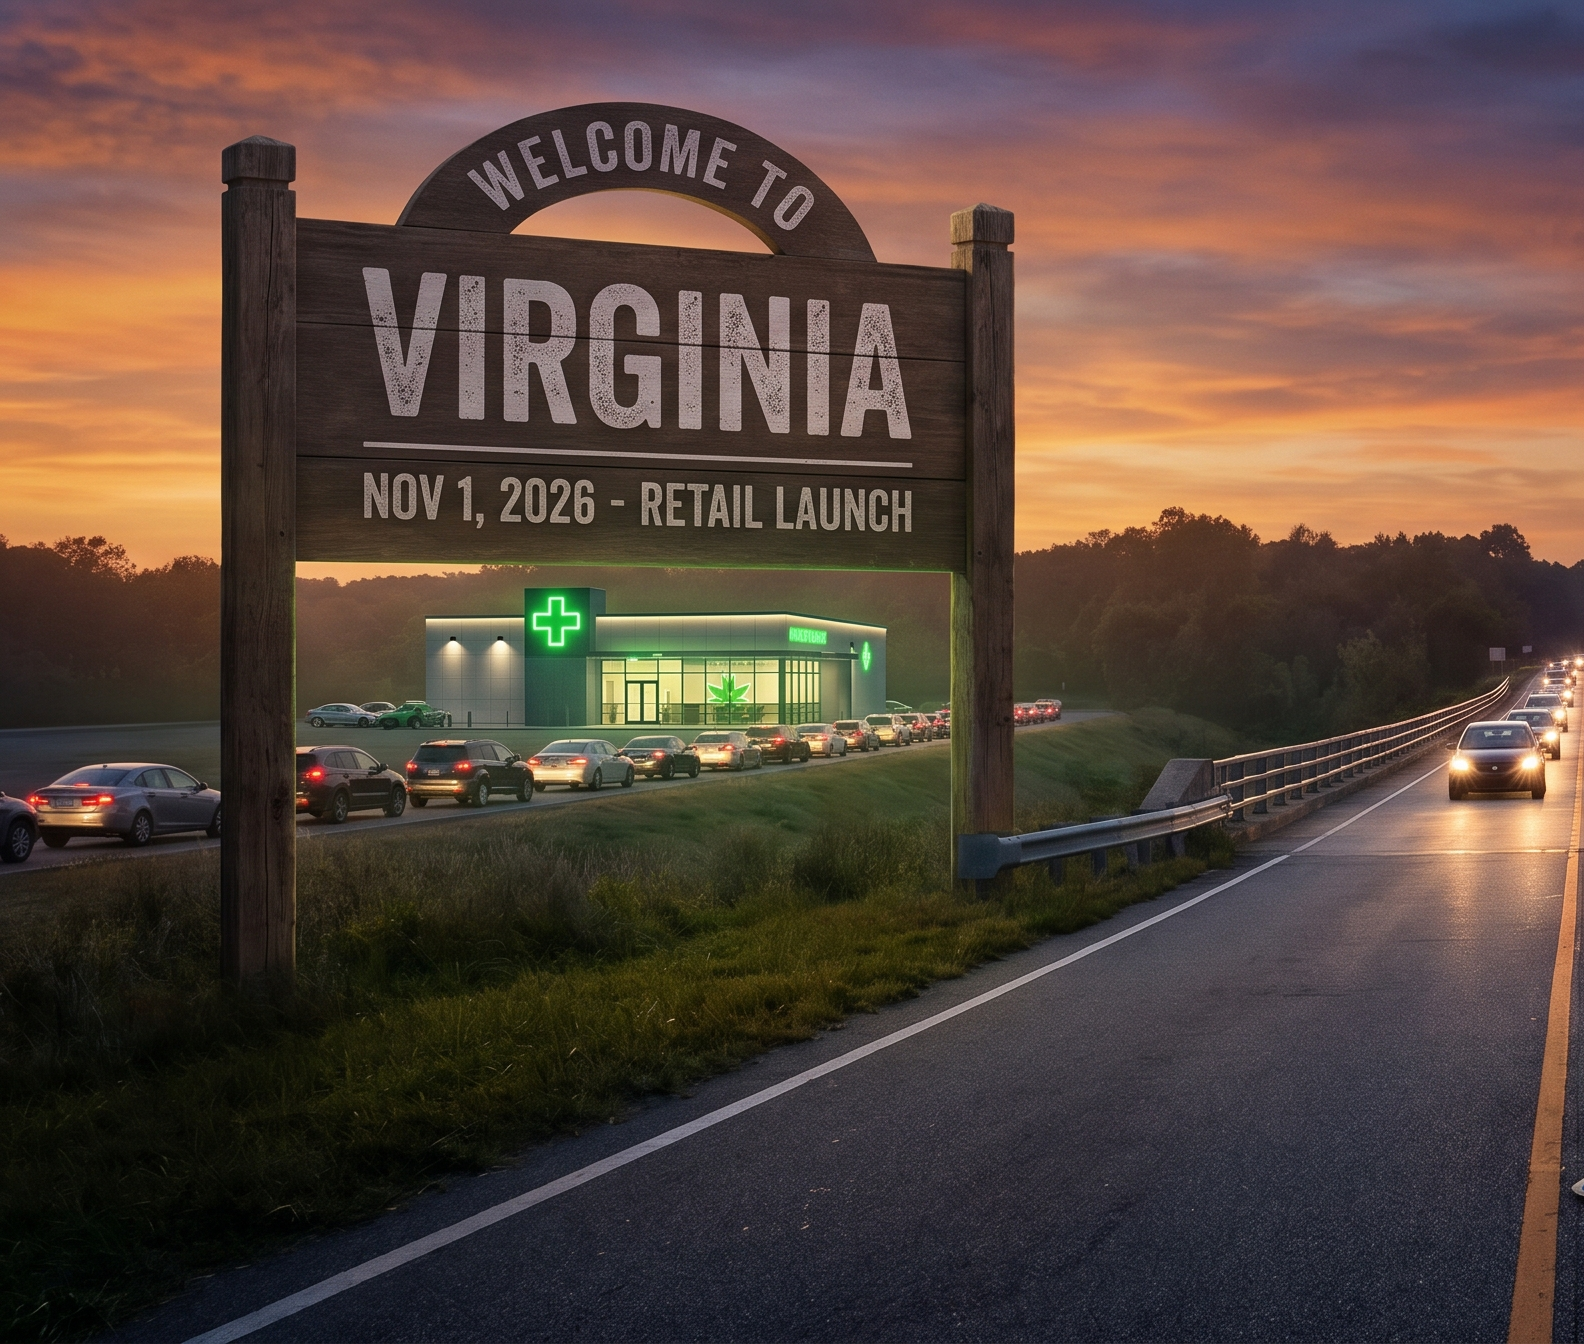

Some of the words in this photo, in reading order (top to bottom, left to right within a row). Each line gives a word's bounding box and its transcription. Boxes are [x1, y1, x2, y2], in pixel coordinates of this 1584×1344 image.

[467, 120, 738, 211] WELCOME
[749, 160, 815, 231] TO
[362, 267, 913, 439] VIRGINIA
[362, 472, 445, 520] NOV
[457, 477, 485, 530] 1,
[500, 476, 596, 525] 2026
[640, 481, 763, 530] RETAIL
[775, 485, 913, 533] LAUNCH
